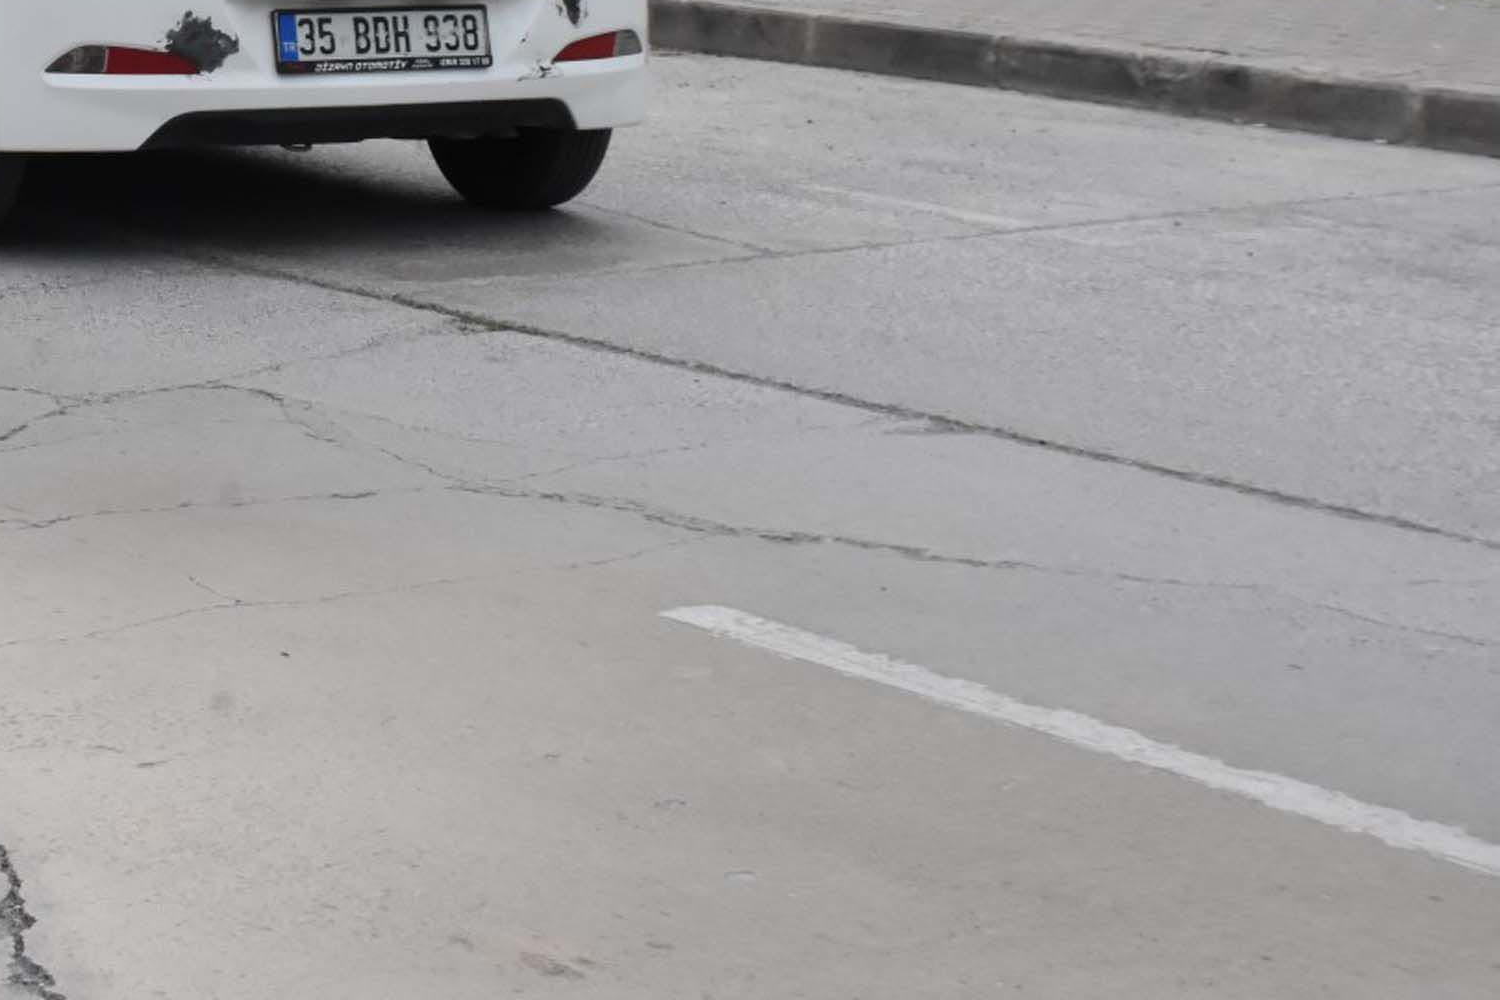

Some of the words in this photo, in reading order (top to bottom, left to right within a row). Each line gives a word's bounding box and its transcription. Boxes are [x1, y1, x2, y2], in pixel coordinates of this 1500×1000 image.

[298, 17, 336, 55] 35
[353, 16, 411, 54] BDH
[424, 14, 479, 52] 938
